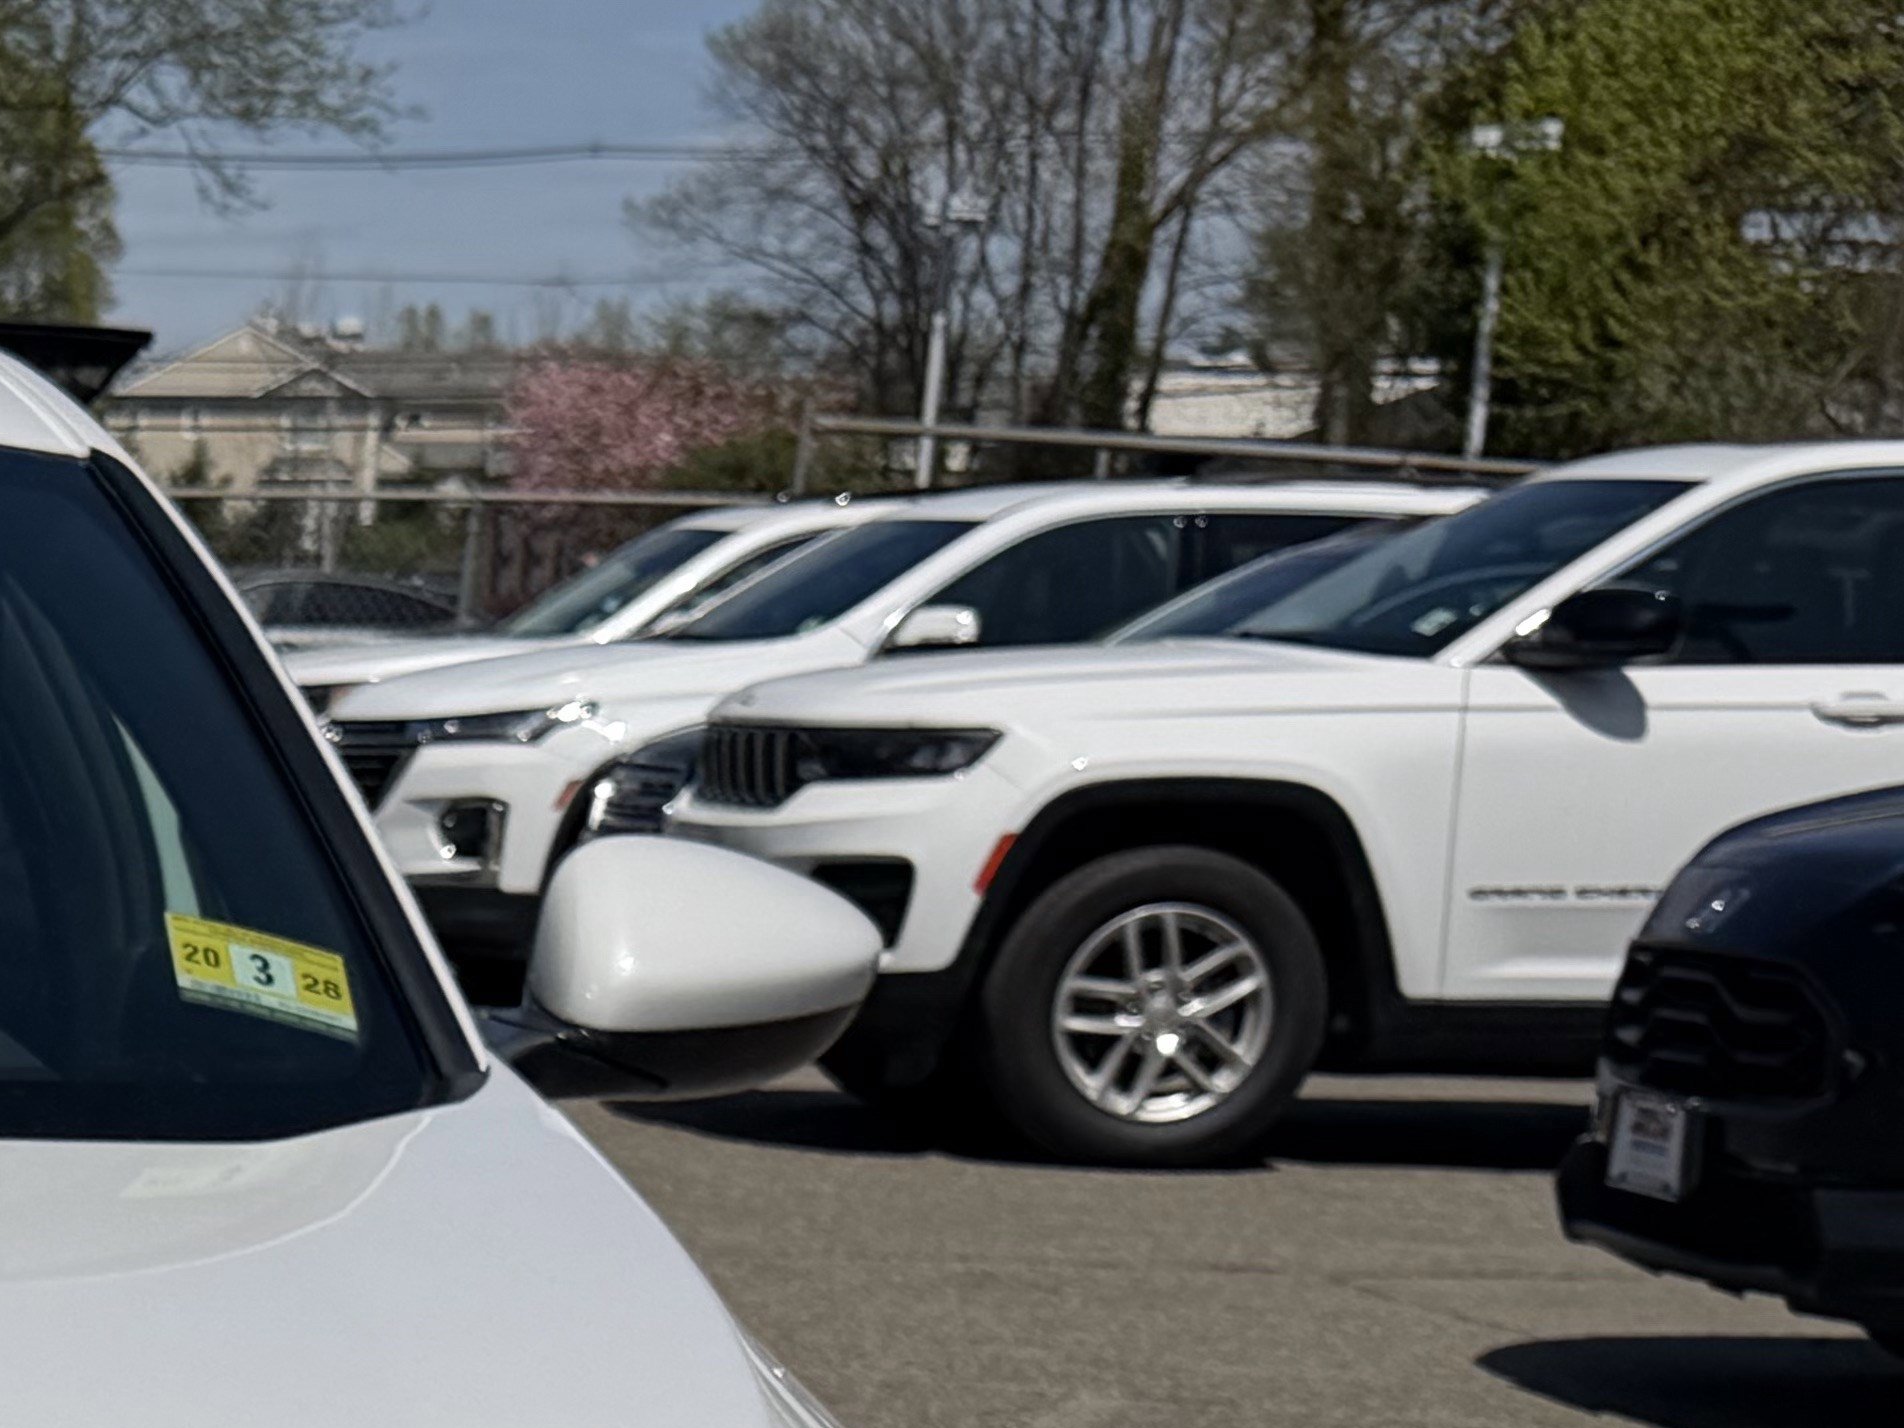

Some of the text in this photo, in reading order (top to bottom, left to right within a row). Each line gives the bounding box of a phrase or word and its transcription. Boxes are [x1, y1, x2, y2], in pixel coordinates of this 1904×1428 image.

[181, 942, 221, 969] 20
[248, 953, 275, 987] 3
[301, 972, 343, 1001] 28
